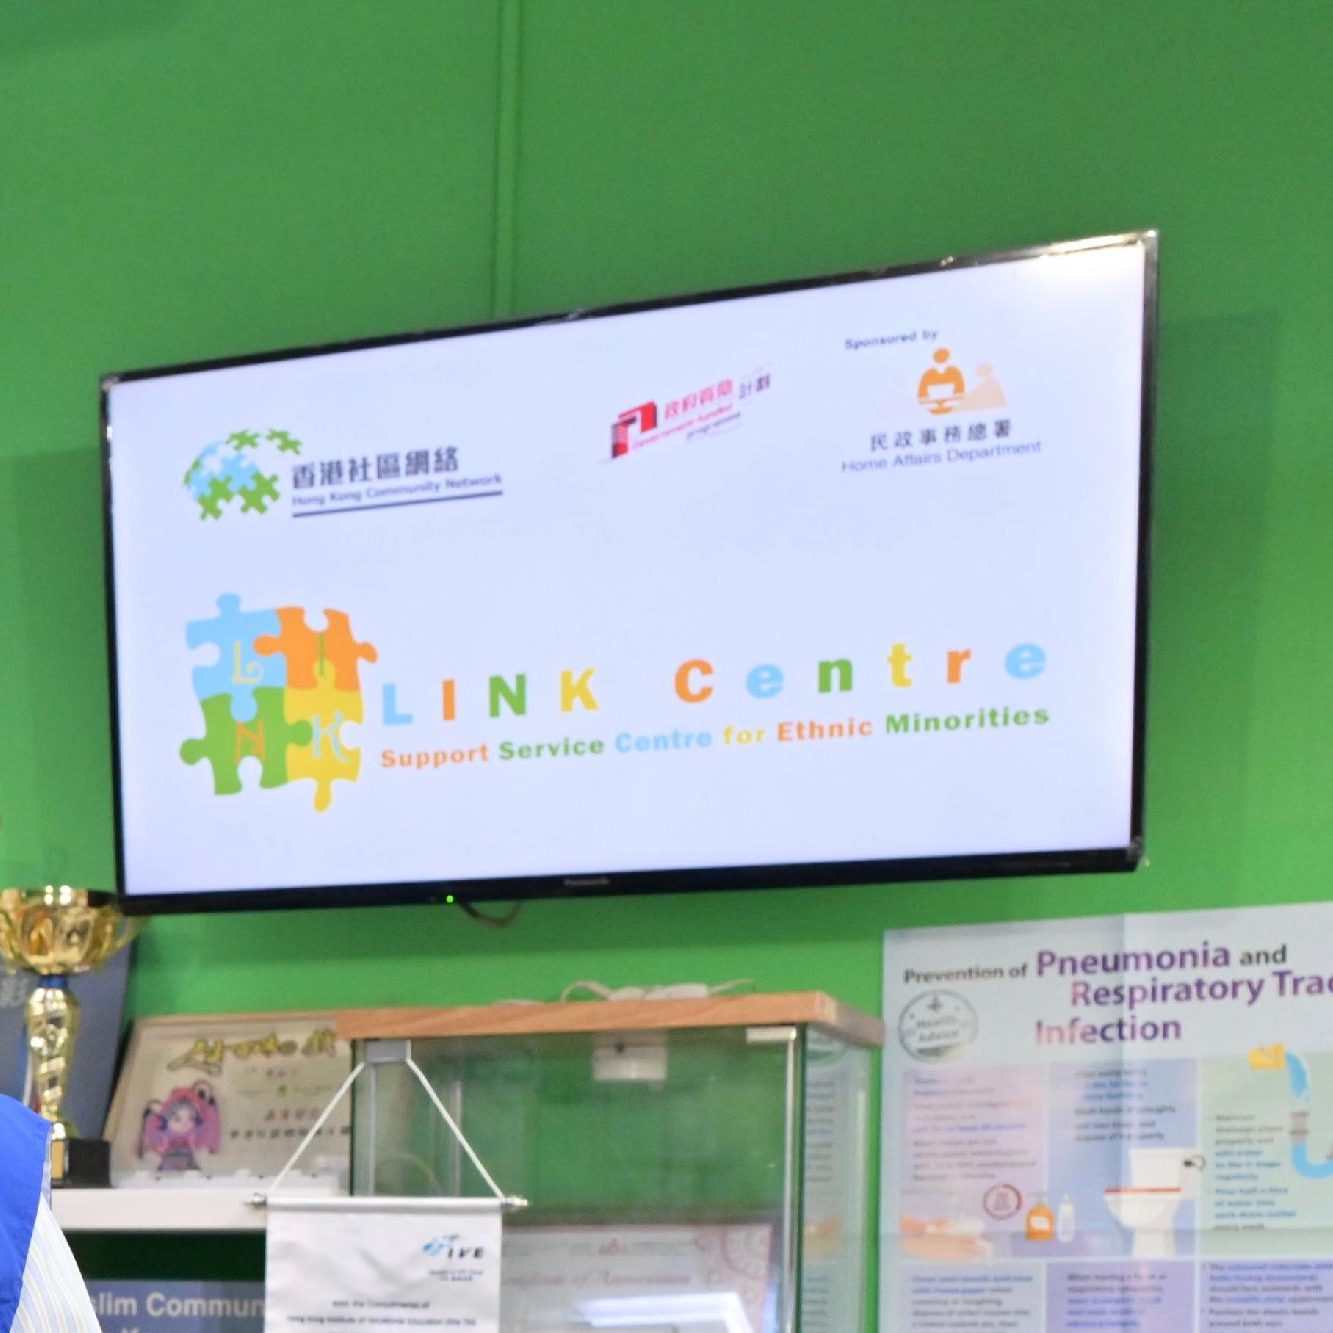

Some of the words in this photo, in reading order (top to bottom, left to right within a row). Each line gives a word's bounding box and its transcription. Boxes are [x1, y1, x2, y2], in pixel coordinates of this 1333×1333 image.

[845, 332, 916, 349] Sponsored
[922, 329, 938, 343] by
[871, 419, 1011, 452] 民政事務總署
[842, 457, 887, 473] Home
[893, 451, 941, 467] Affairs
[947, 441, 1041, 462] Department
[292, 495, 325, 507] Hong
[330, 491, 362, 503] Kong
[366, 481, 440, 499] Community
[446, 473, 502, 489] Network
[383, 668, 599, 726] LINK
[674, 642, 1047, 704] Centre
[380, 744, 488, 769] Support
[499, 736, 604, 761] Service
[615, 727, 713, 754] Centre
[723, 725, 766, 746] for
[777, 716, 874, 742] Ethnic
[885, 706, 1050, 735] Minorities
[904, 966, 1004, 985] Prevention
[1008, 964, 1028, 979] of
[1037, 940, 1231, 976] Pneumonia
[1240, 945, 1288, 967] and
[1070, 972, 1265, 1010] Respiratory
[1035, 1015, 1182, 1045] Infection
